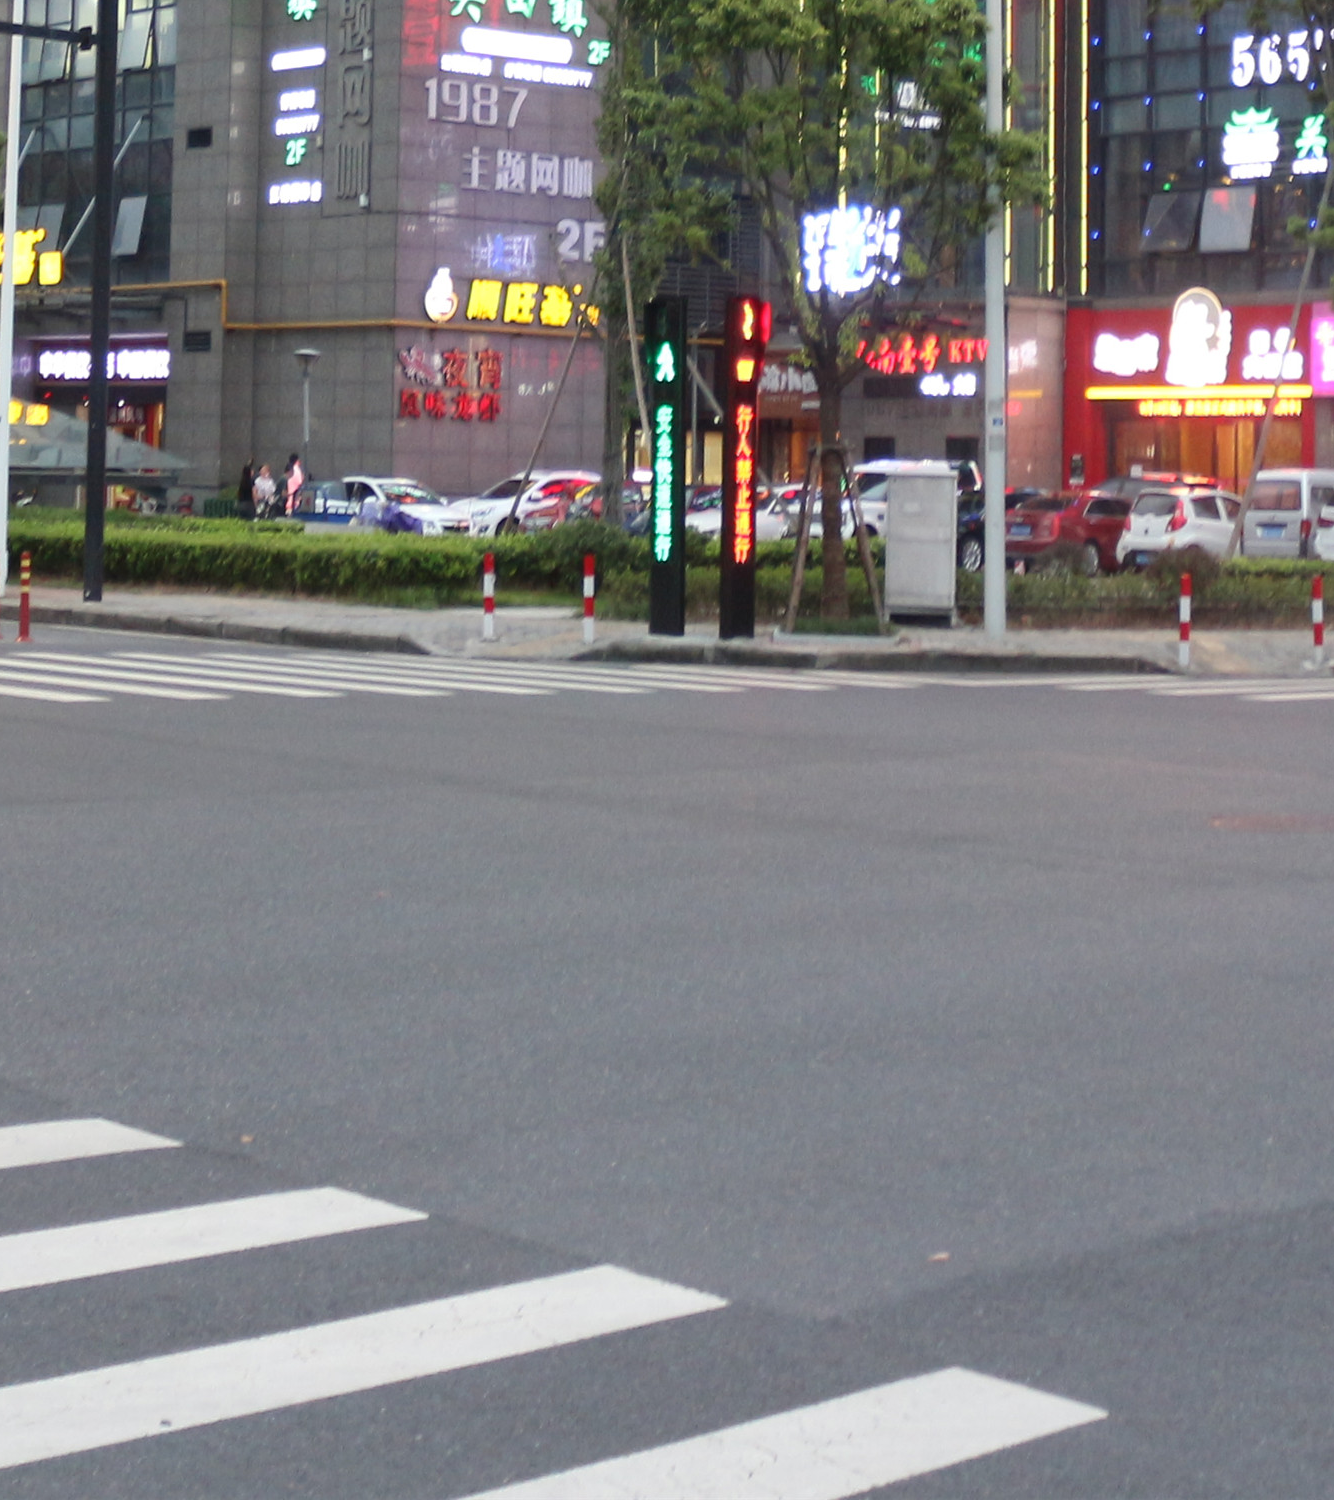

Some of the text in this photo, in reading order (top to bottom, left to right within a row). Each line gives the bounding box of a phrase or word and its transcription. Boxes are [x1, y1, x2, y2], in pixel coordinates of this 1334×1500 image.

[587, 39, 612, 66] 2F
[424, 76, 529, 130] 1987
[284, 137, 308, 167] 2F
[460, 145, 594, 200] 主题网咖
[556, 218, 607, 263] 2F
